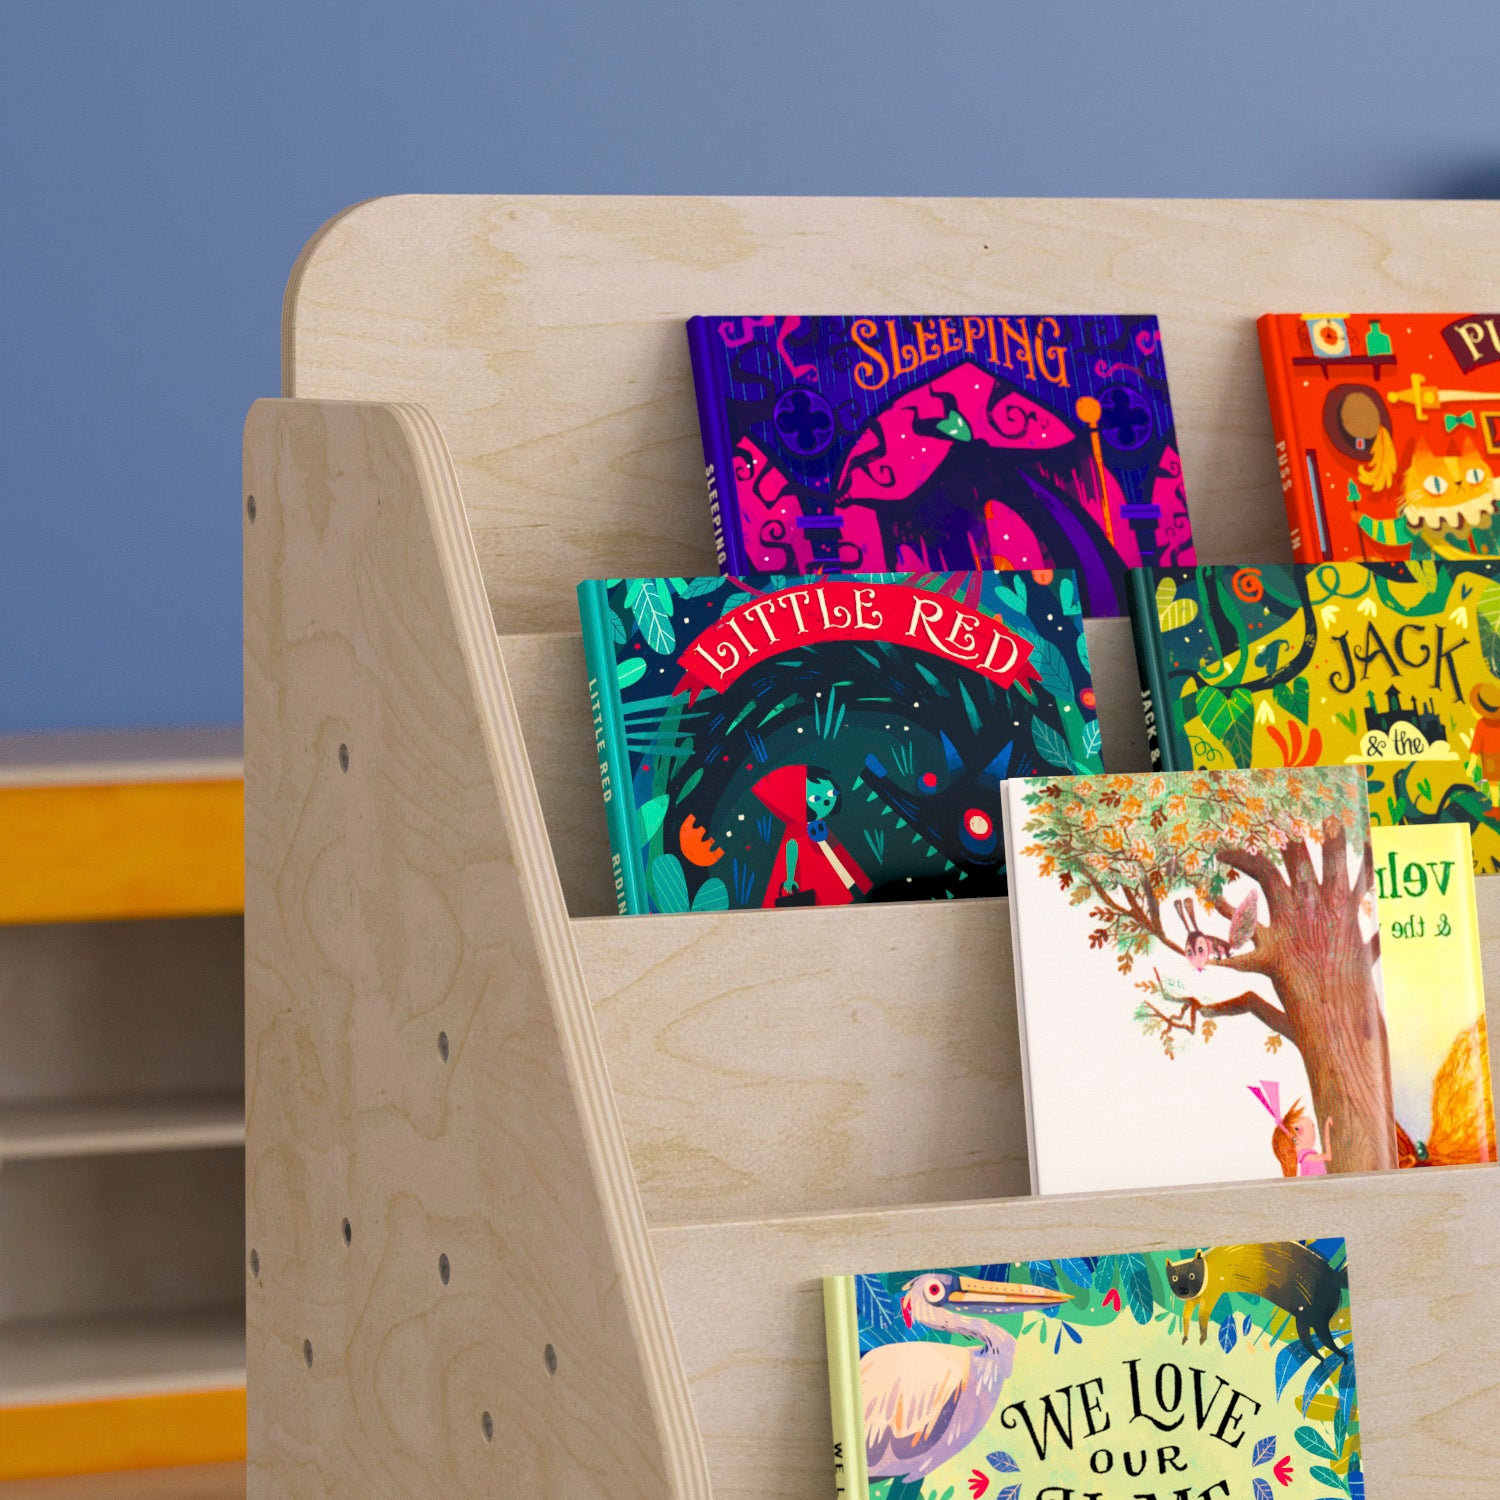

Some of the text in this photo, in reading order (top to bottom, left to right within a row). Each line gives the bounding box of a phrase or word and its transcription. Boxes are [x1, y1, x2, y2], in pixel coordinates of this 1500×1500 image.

[850, 316, 1071, 391] SLEEPING
[705, 463, 727, 565] SLEEPING
[1275, 440, 1302, 550] PUSS IN
[693, 586, 1019, 680] LITTLE RED
[1329, 620, 1470, 705] JACK
[588, 678, 606, 753] LITTLE
[599, 761, 612, 804] RED
[1140, 689, 1160, 764] JACK &
[1365, 728, 1425, 757] & the
[1000, 1358, 1262, 1461] WE LOVE
[833, 1441, 845, 1475] WE
[1090, 1445, 1188, 1477] OUR
